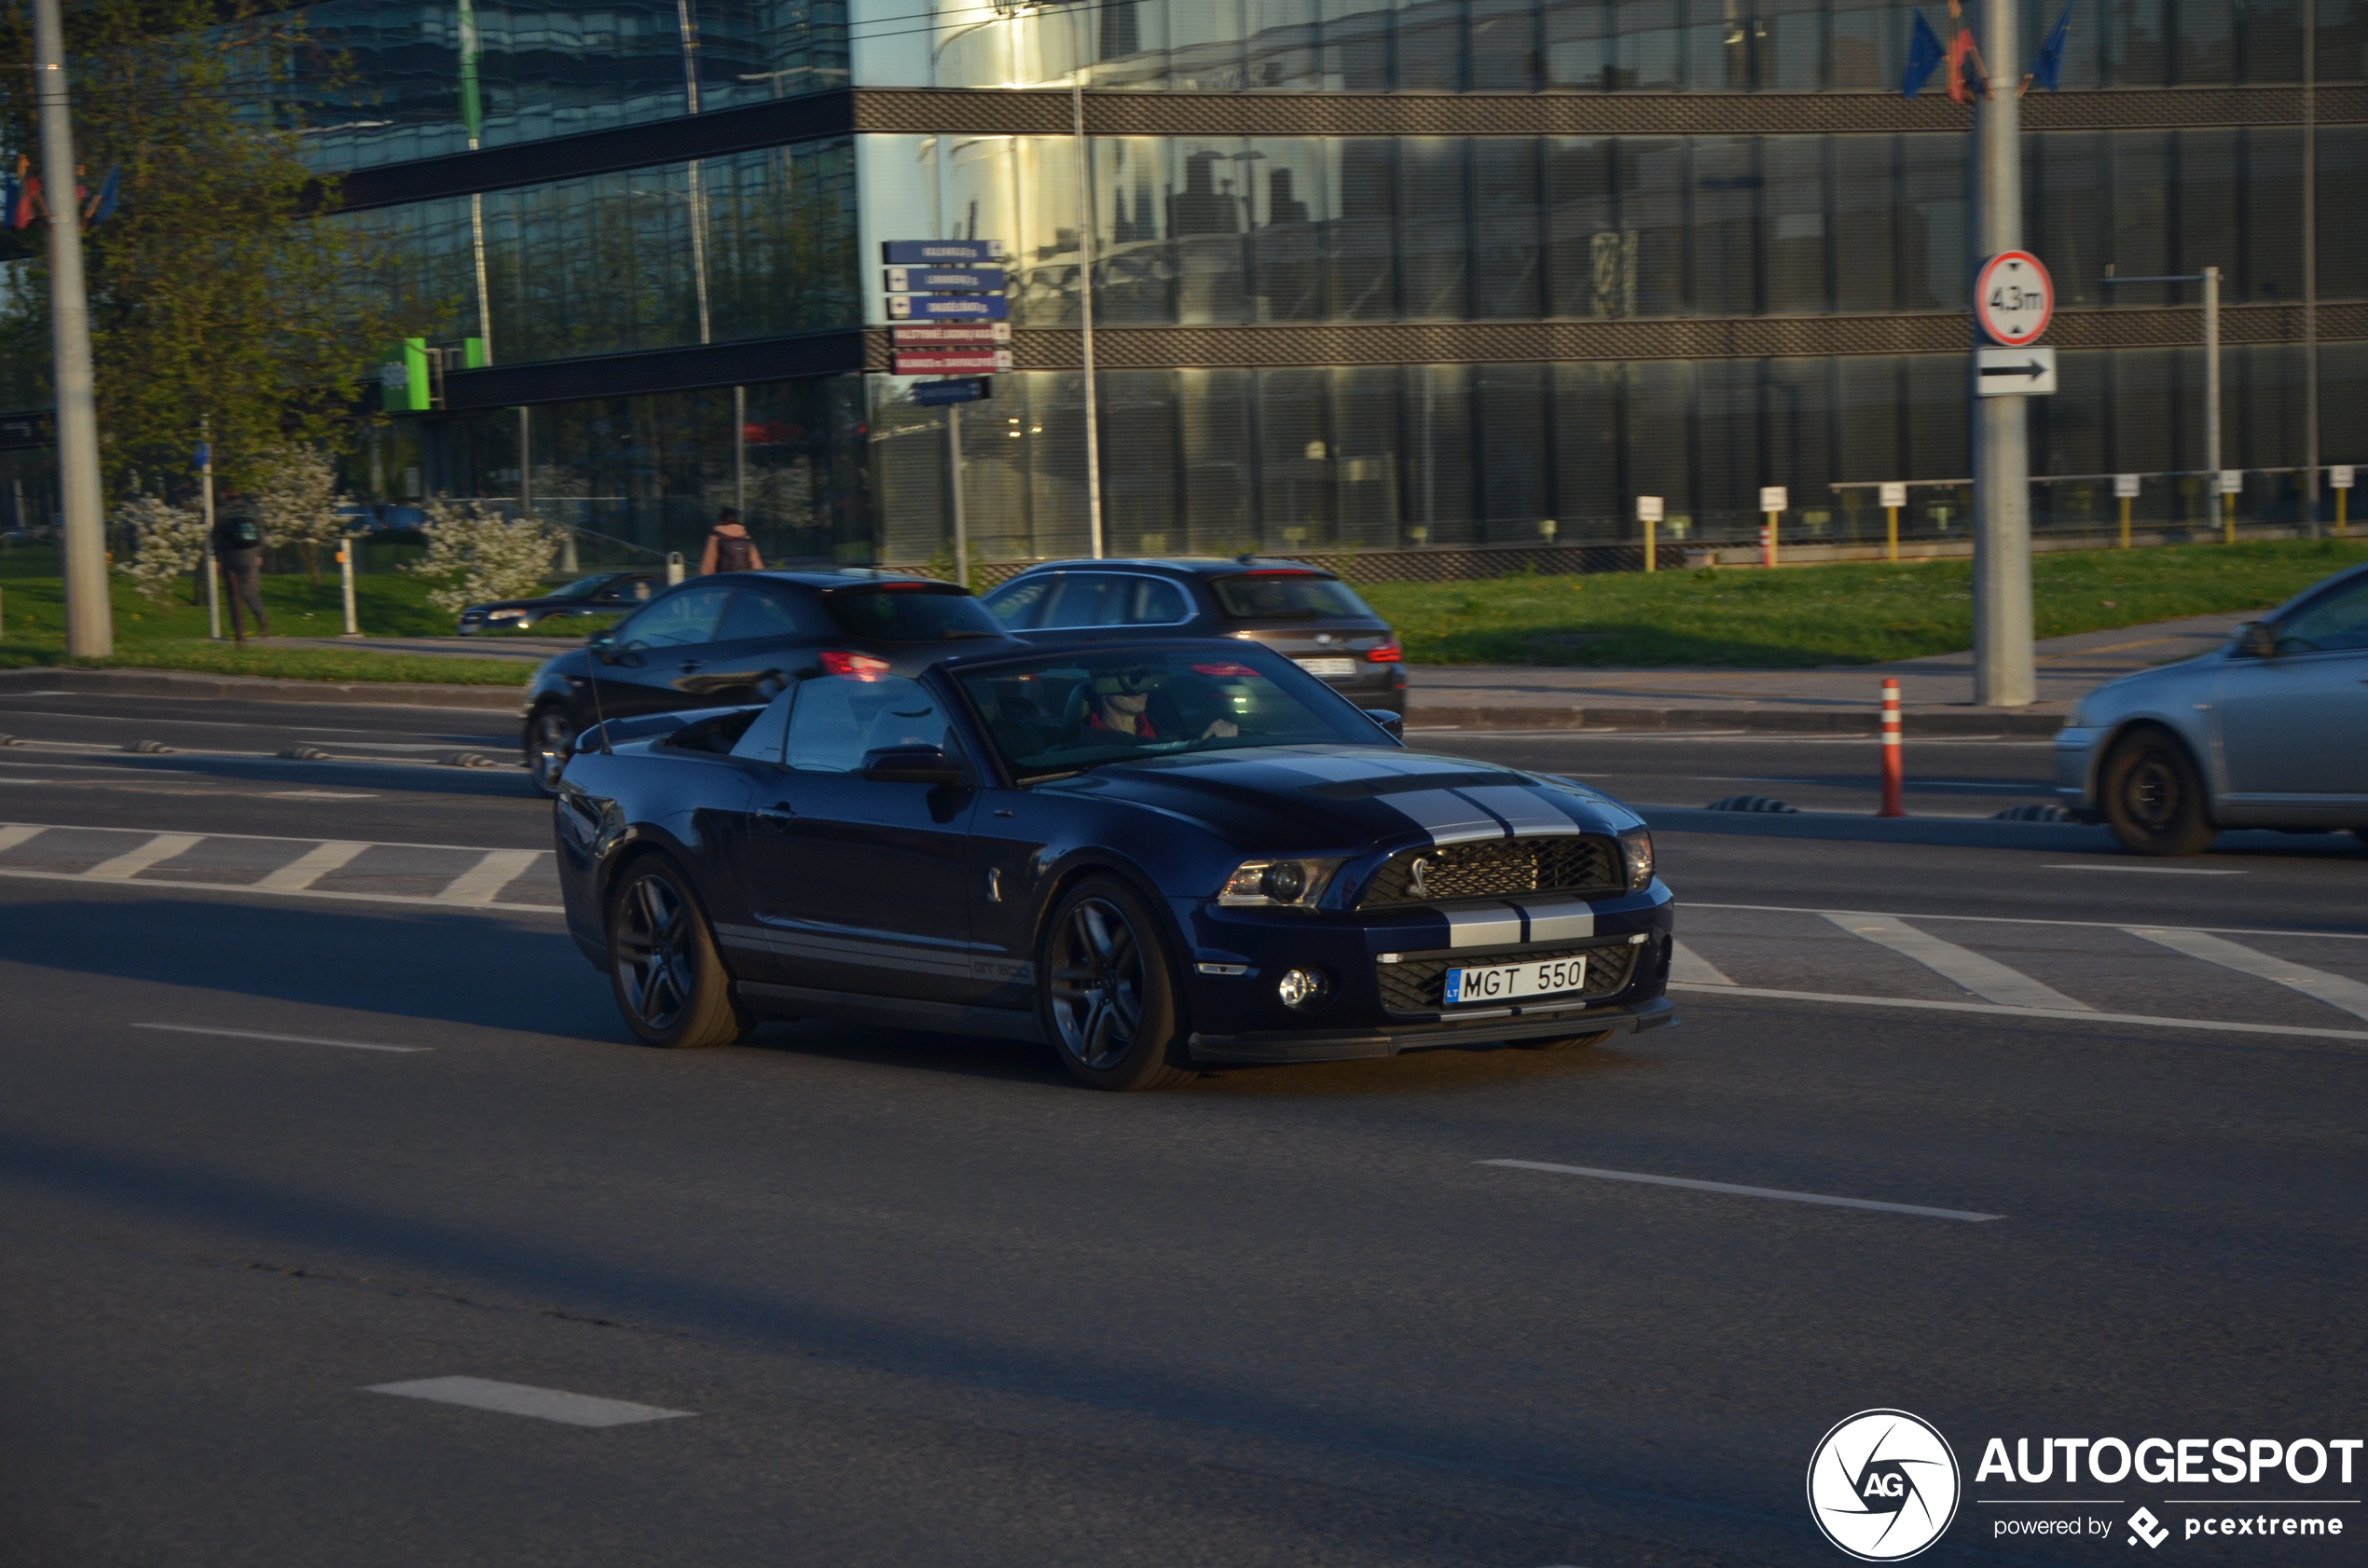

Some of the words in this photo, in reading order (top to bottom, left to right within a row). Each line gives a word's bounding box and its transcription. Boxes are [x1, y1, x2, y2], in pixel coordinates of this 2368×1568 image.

[1446, 988, 1459, 997] LT
[1464, 968, 1521, 997] MGT
[1537, 961, 1581, 990] 550
